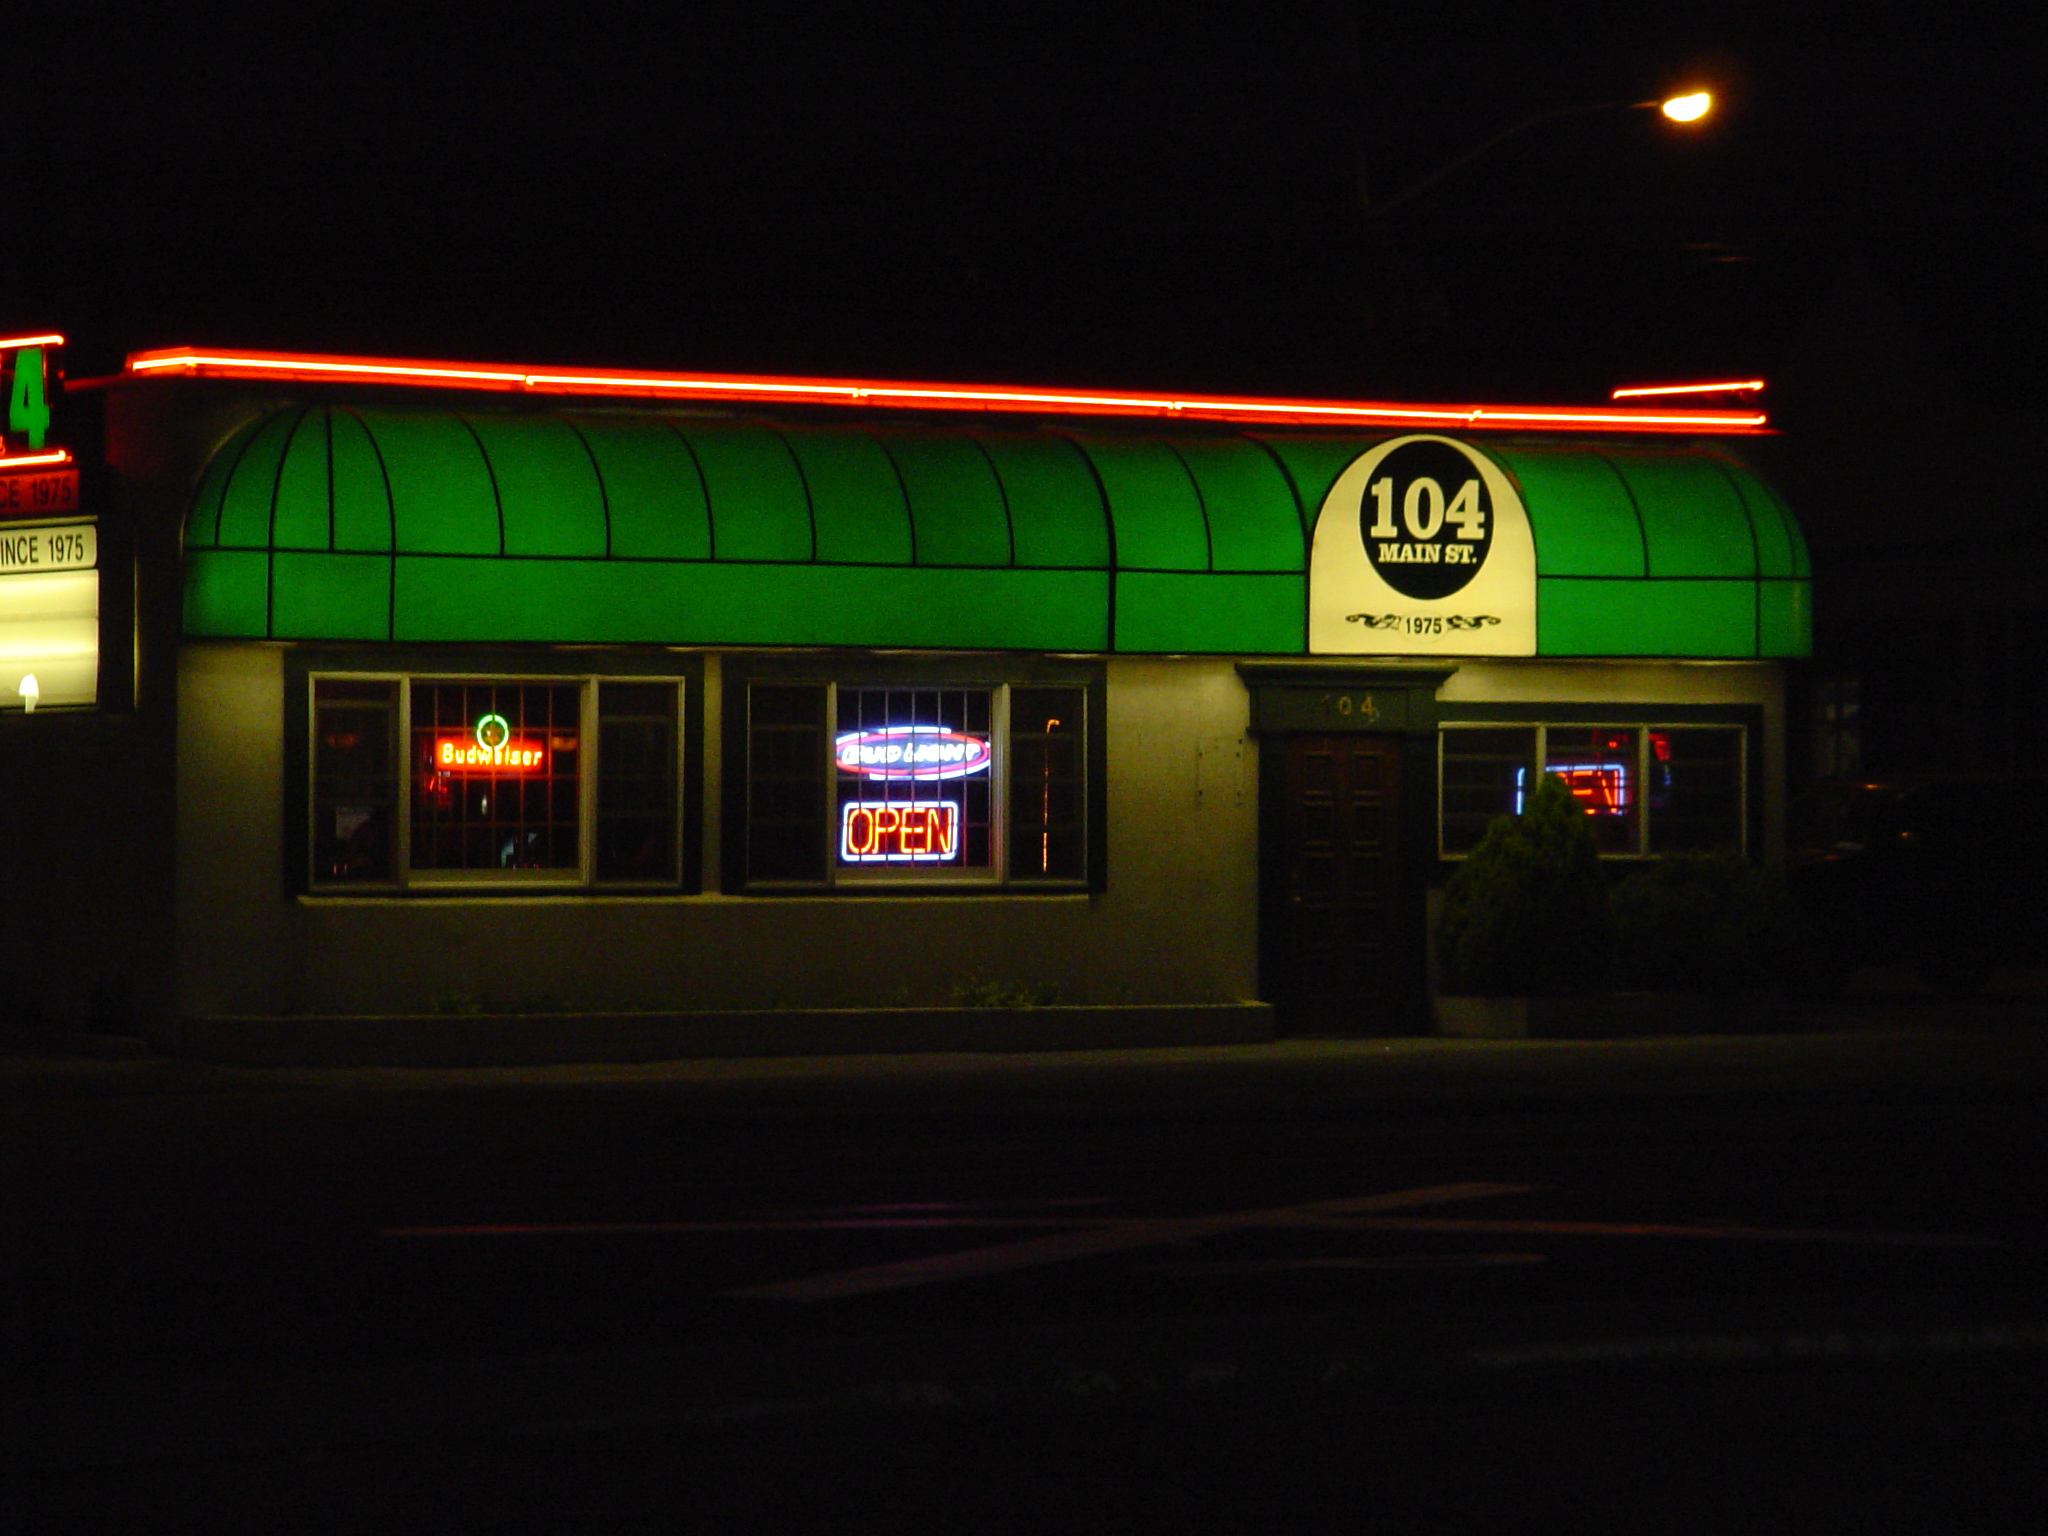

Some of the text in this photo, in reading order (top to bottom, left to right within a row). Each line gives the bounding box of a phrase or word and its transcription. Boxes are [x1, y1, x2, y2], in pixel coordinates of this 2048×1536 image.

[30, 476, 72, 505] 1975
[1370, 477, 1485, 540] 104
[48, 533, 84, 562] 1975
[1378, 543, 1477, 564] MAIN ST.
[1405, 617, 1442, 634] 1975
[848, 807, 952, 855] OPEN
